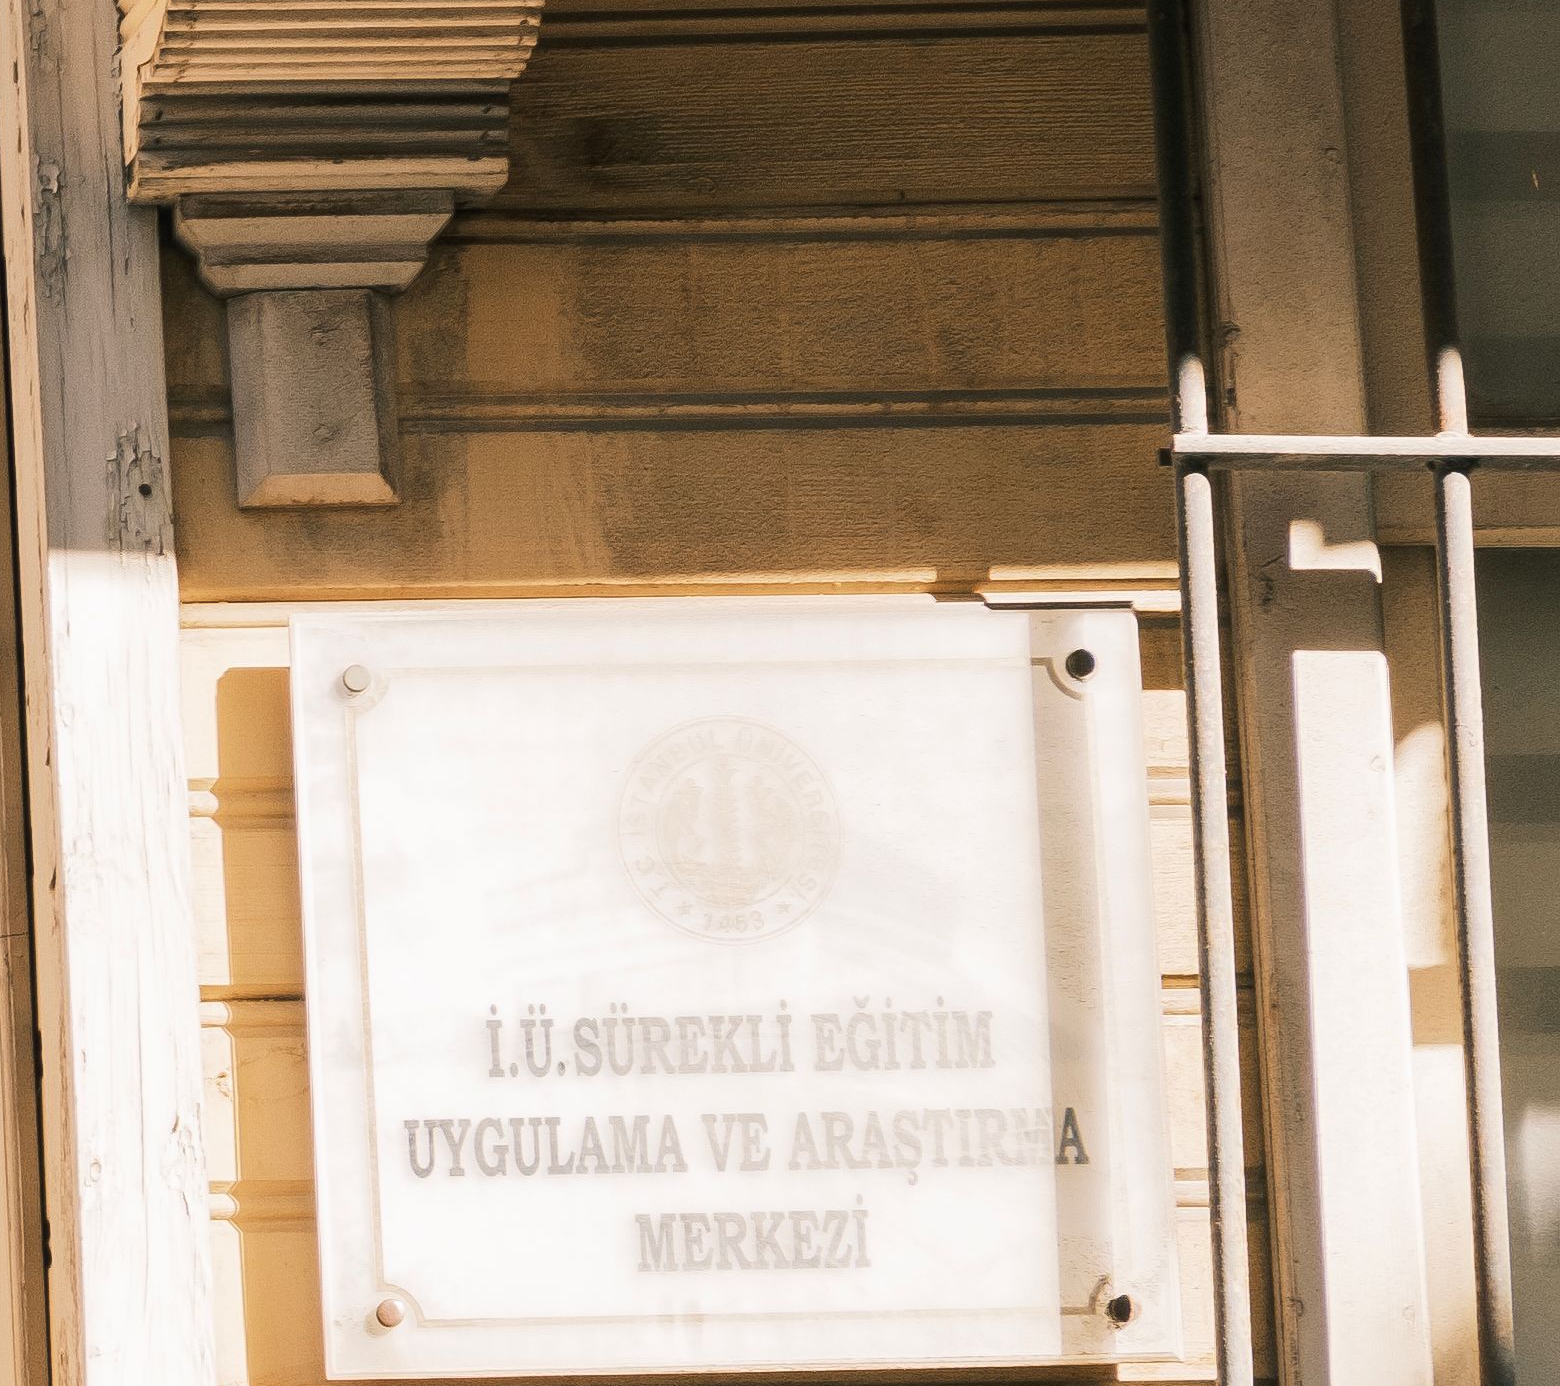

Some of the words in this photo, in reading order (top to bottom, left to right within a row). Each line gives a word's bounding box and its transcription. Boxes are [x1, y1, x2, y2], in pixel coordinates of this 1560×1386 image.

[703, 910, 766, 934] 1453
[811, 995, 996, 1072] EĞİTİM
[404, 1114, 689, 1178] UYGULAMA
[701, 1112, 771, 1172] VE
[787, 1107, 1090, 1186] ARAŞTIRMA
[635, 1194, 872, 1272] MERKEZİ
